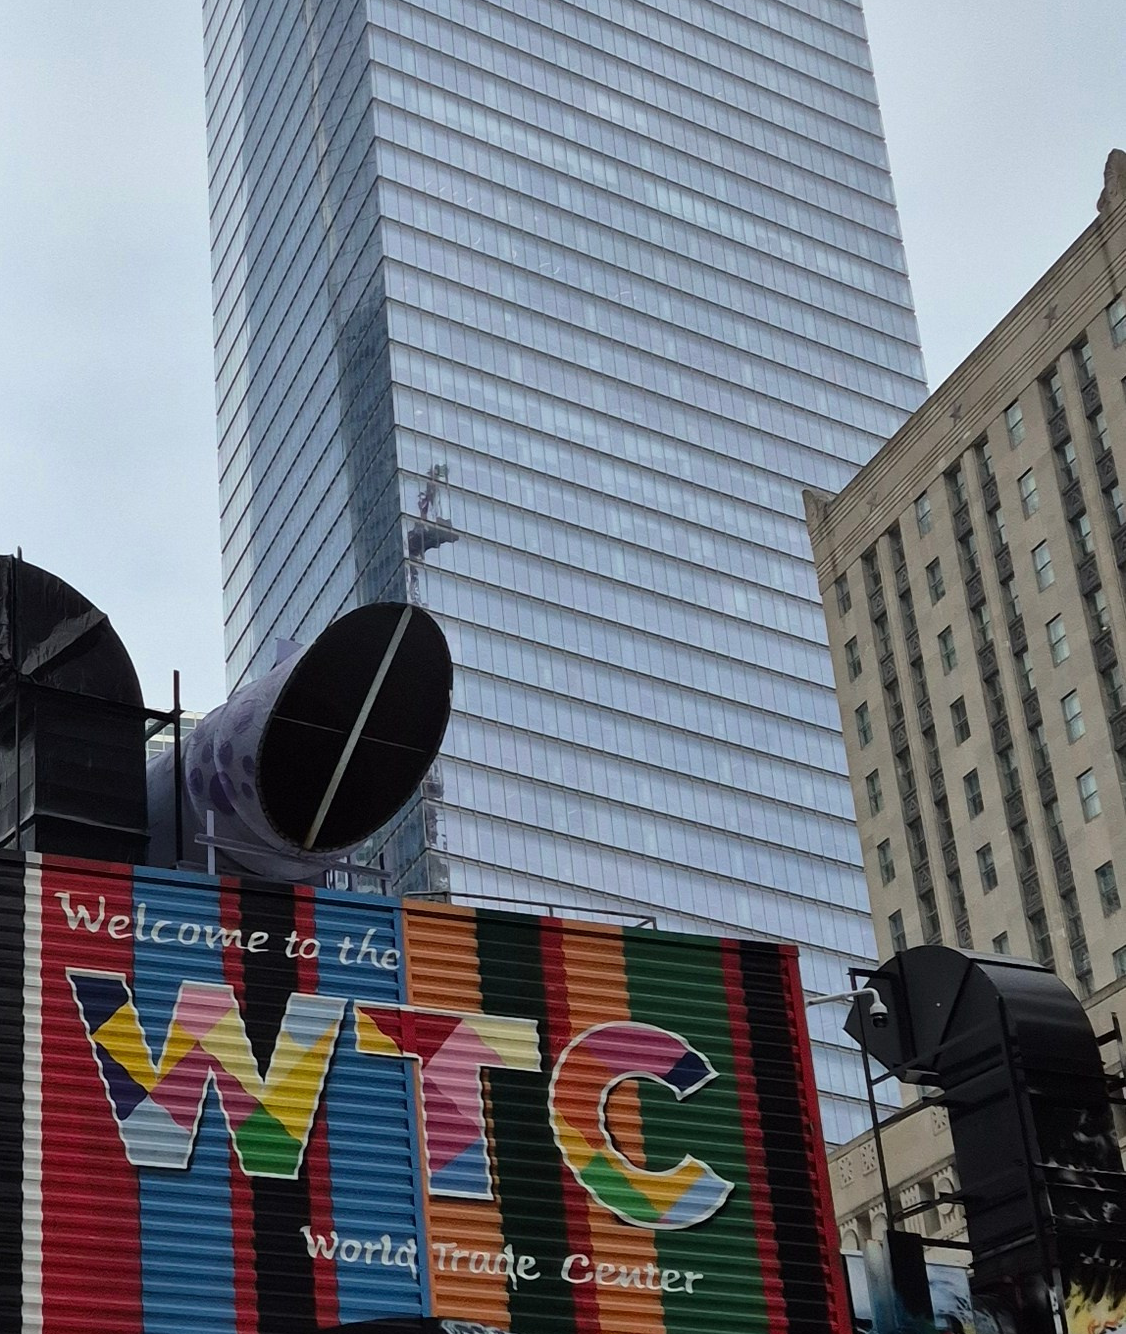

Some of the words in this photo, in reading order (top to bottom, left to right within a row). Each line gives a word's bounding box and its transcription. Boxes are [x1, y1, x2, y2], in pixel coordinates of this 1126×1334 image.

[54, 891, 269, 952] Welcome
[285, 930, 320, 959] to
[337, 928, 400, 970] the
[65, 967, 735, 1229] WTC
[299, 1225, 418, 1280] World
[432, 1243, 541, 1291] Trade
[561, 1254, 704, 1294] Center
